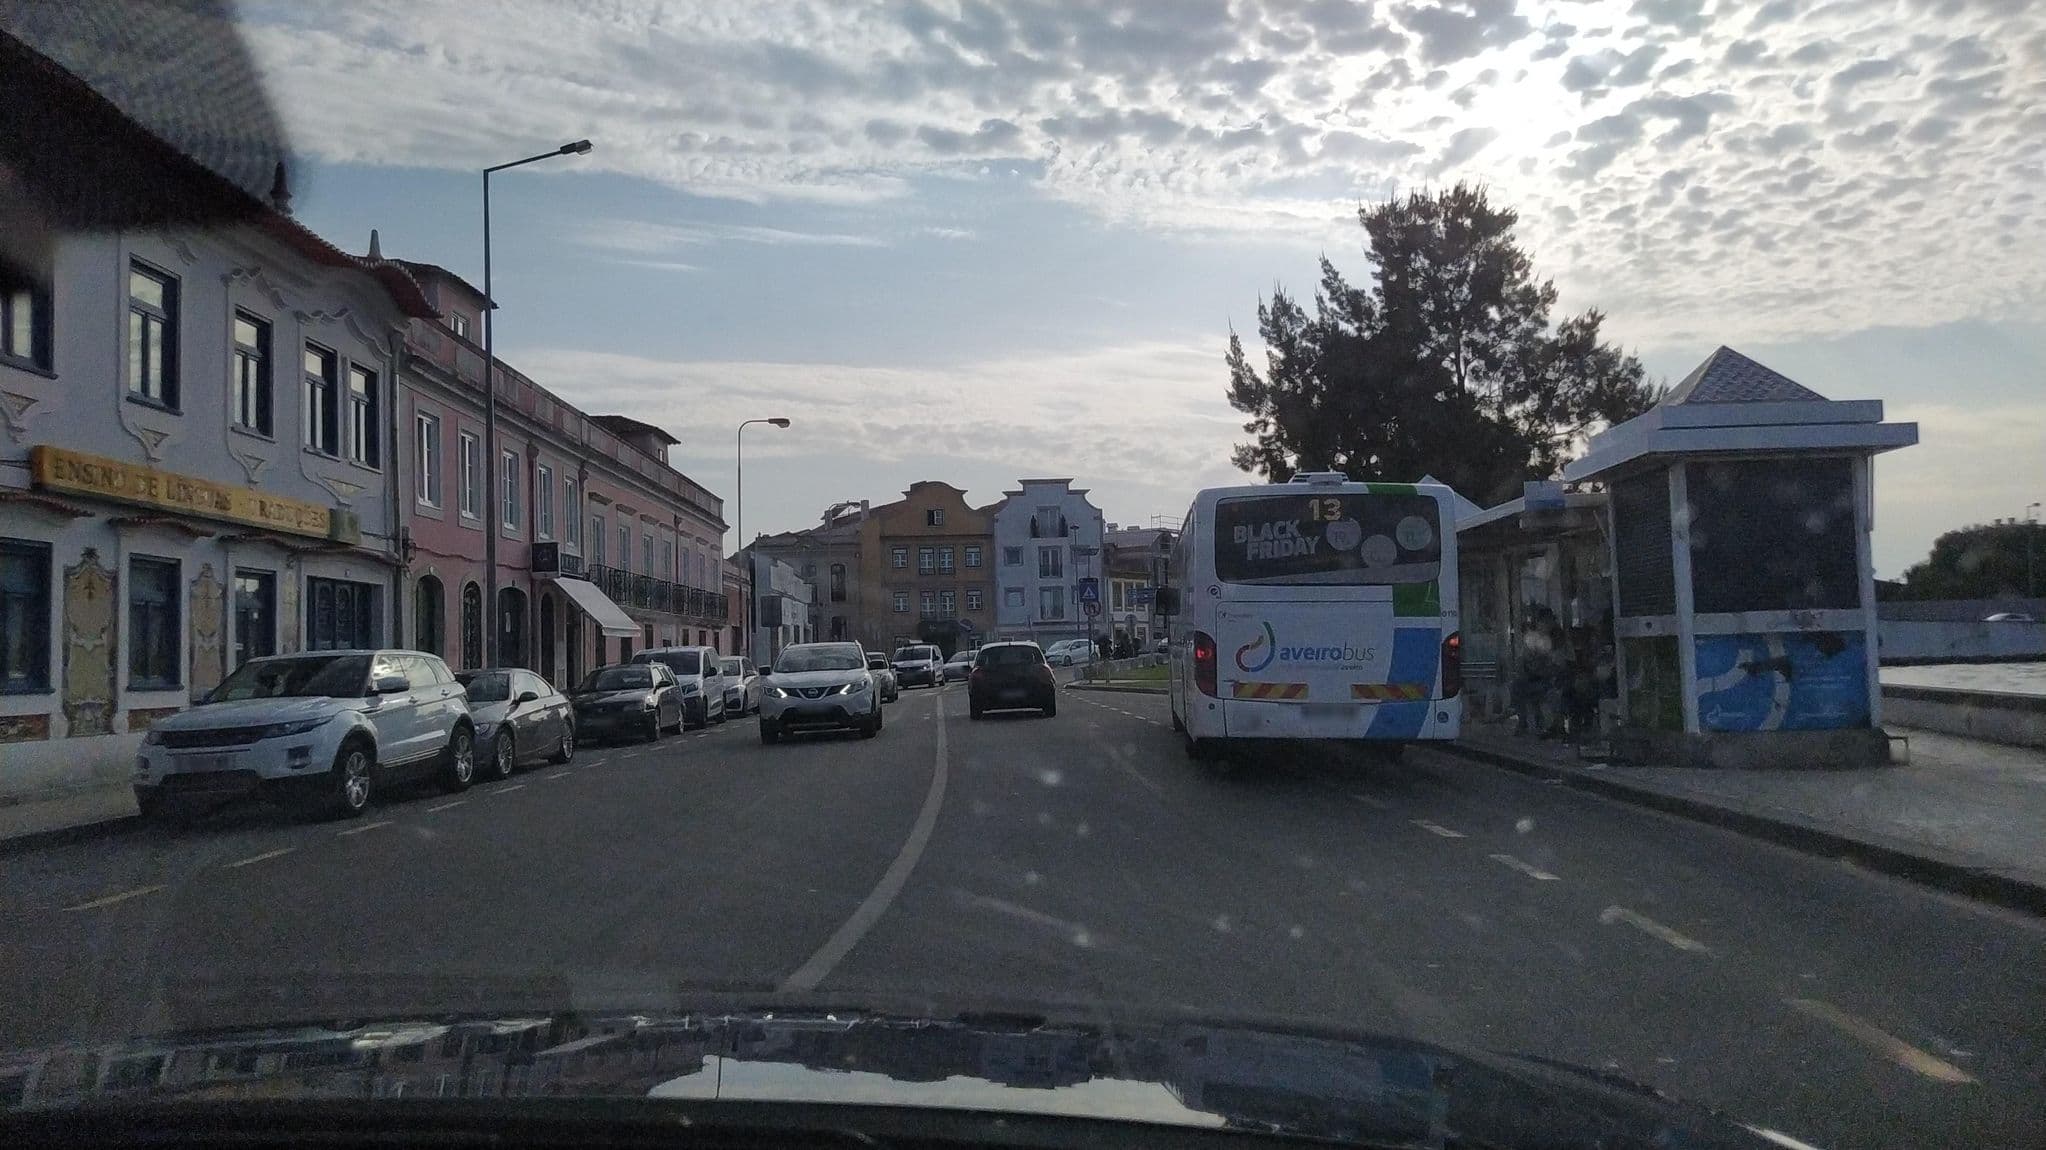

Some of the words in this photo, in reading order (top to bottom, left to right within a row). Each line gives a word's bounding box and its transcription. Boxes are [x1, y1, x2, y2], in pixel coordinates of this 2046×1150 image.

[55, 458, 124, 488] ENSINO
[136, 473, 158, 497] DE
[1309, 498, 1342, 521] 13
[1234, 519, 1301, 544] BLACK
[1247, 535, 1320, 561] FRIDAY
[1279, 641, 1376, 661] aveirobus
